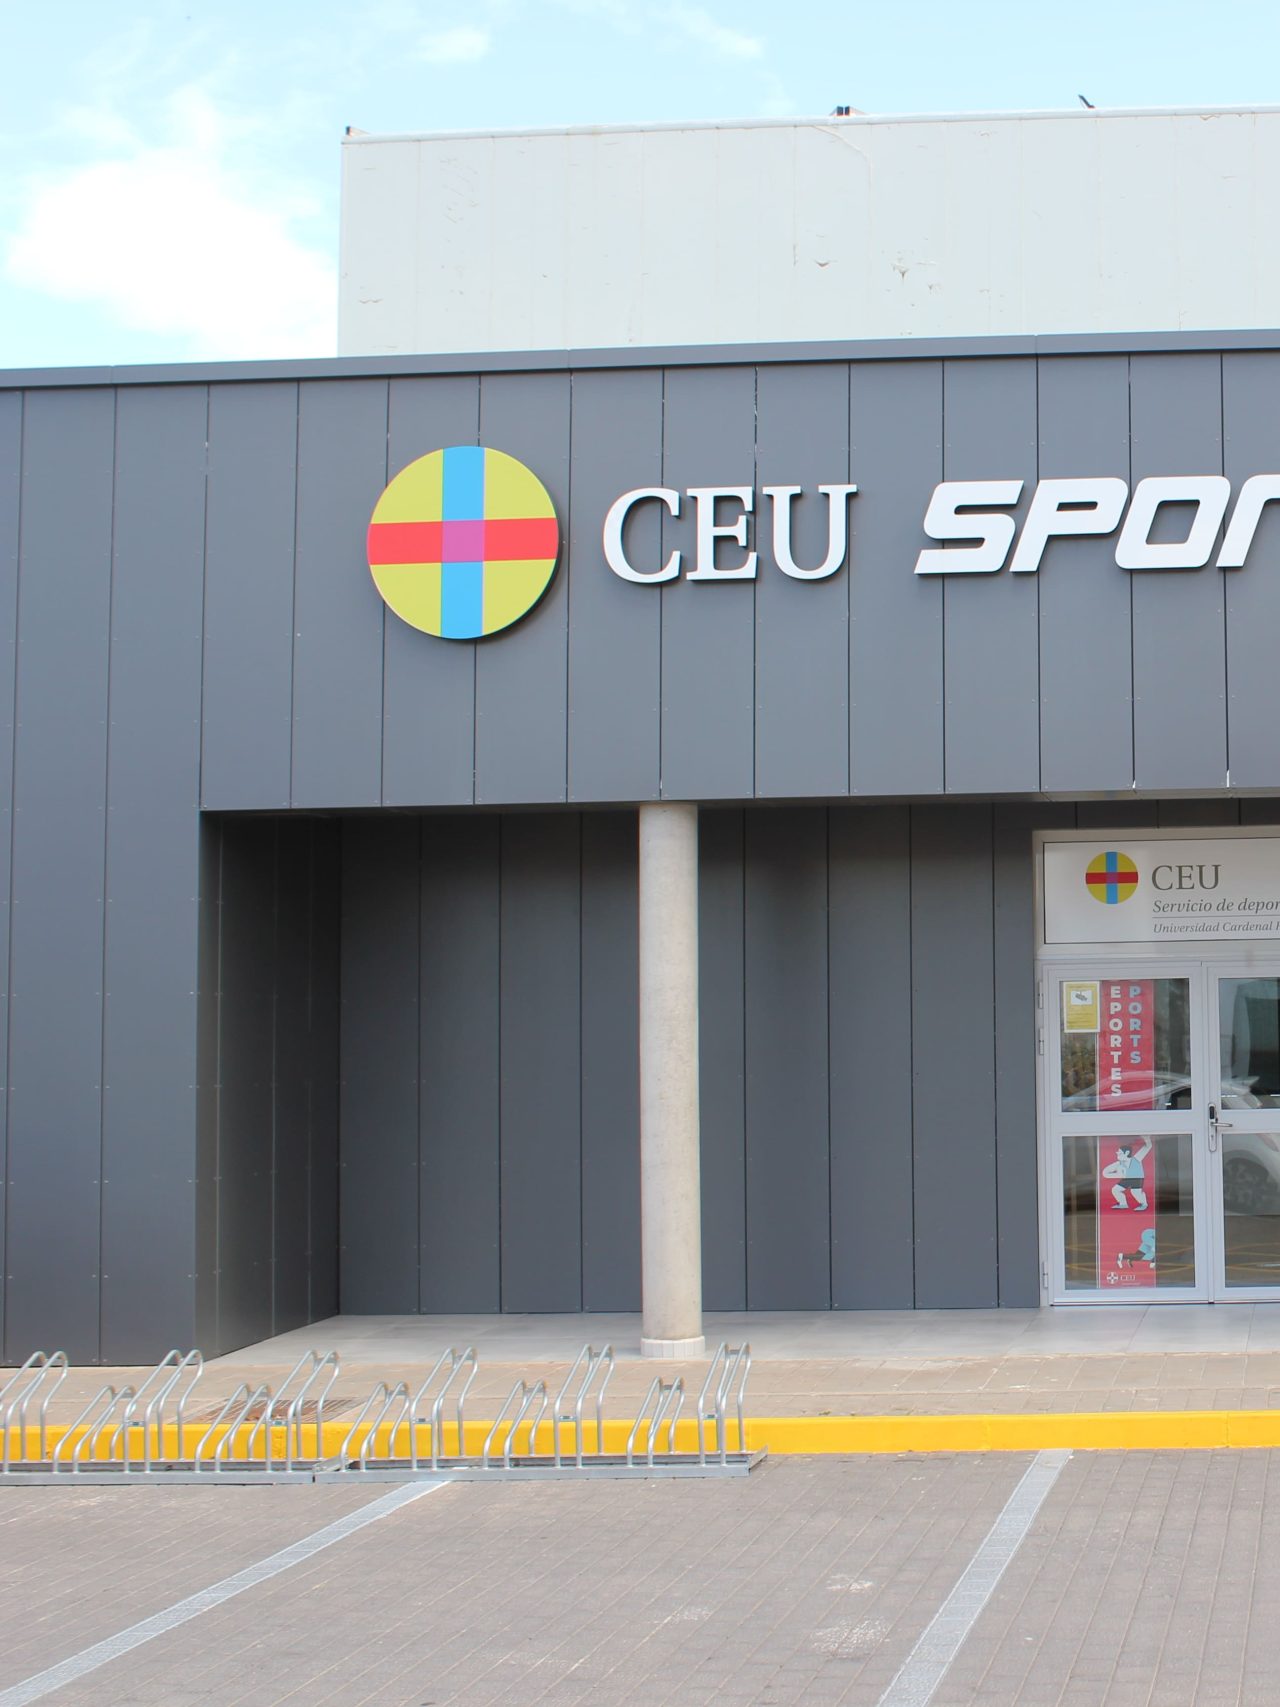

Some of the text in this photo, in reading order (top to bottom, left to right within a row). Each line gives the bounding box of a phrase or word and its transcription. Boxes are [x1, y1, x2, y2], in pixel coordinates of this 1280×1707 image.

[602, 484, 858, 584] CEU
[1151, 864, 1222, 891] CEU
[1152, 898, 1212, 913] Servicio
[1216, 898, 1235, 912] de
[1153, 922, 1220, 934] Universidad
[1222, 921, 1273, 932] Cardenal
[1108, 979, 1123, 1097] EPORTES
[1128, 979, 1142, 1064] PORTS
